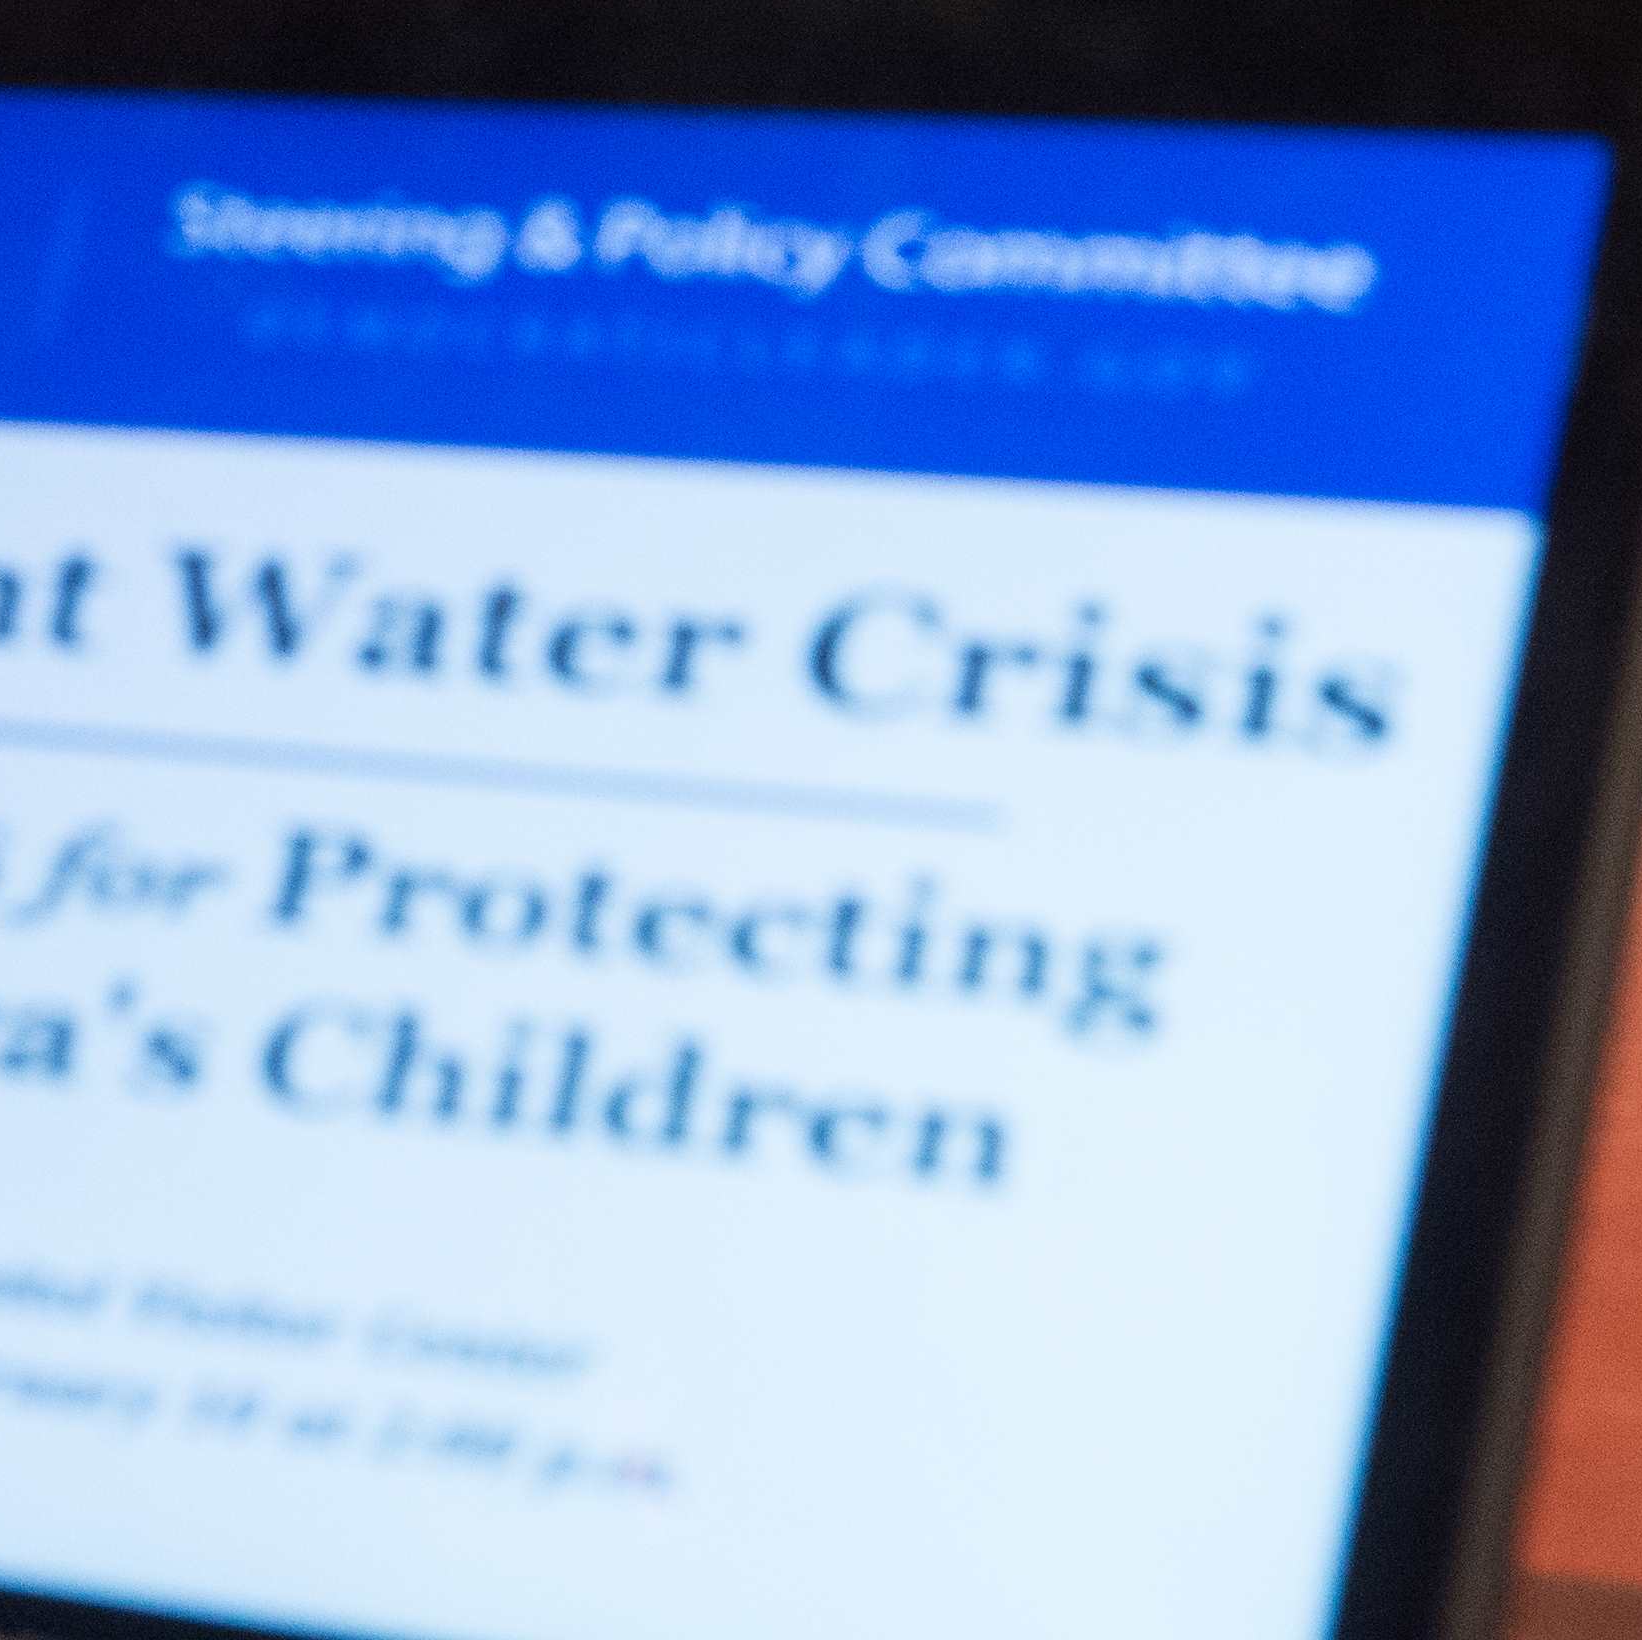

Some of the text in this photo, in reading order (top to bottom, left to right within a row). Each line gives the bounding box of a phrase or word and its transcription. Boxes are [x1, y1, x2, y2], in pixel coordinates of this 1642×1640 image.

[172, 183, 1376, 313] Steering & Policy Committee
[179, 547, 748, 692] Water
[806, 589, 1399, 750] Crisis
[5, 818, 225, 928] for
[270, 825, 1164, 1040] Protecting
[260, 1000, 1012, 1188] Children
